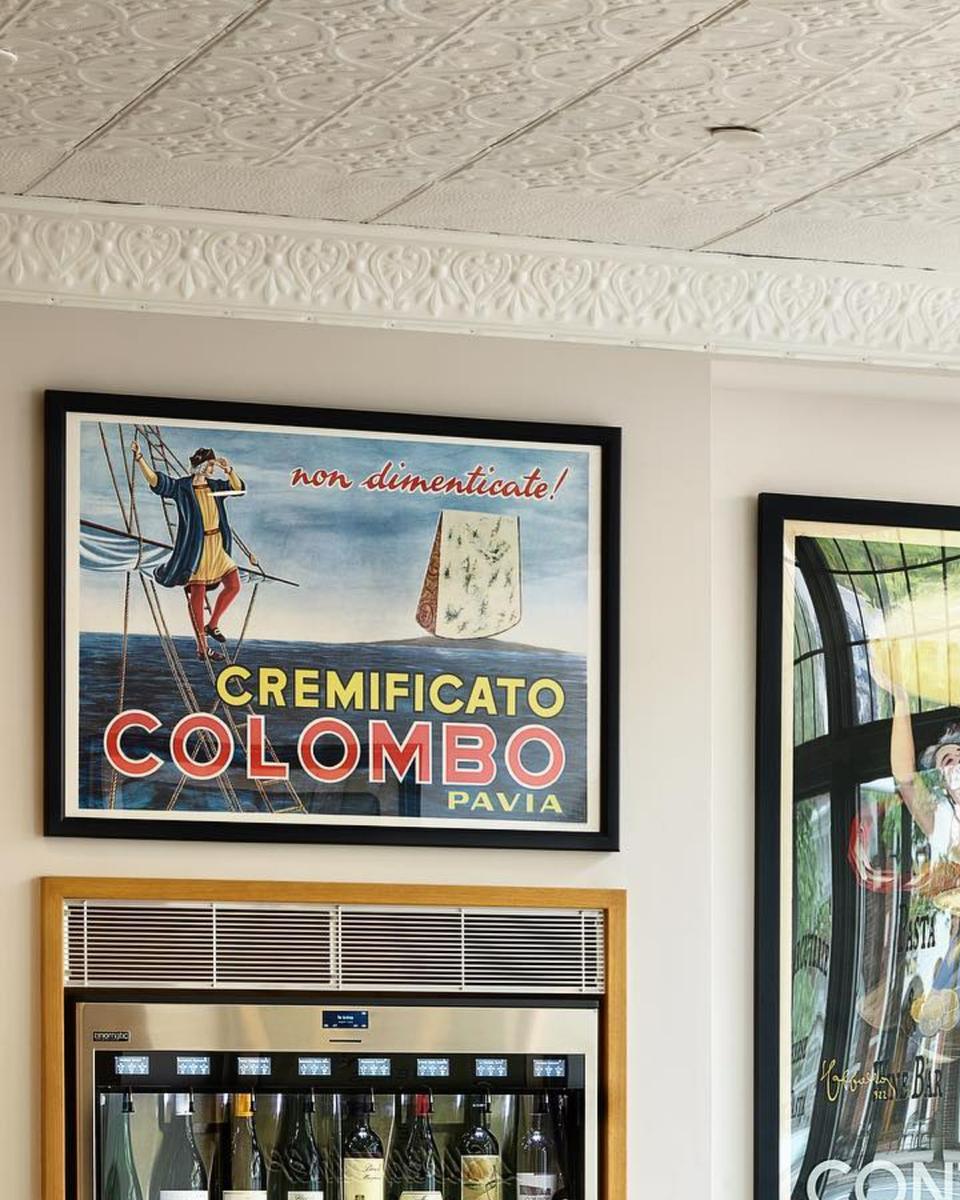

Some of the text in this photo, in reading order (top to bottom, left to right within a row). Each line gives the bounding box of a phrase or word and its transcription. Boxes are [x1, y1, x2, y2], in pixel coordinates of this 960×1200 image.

[291, 461, 569, 500] non dimenticate!
[216, 665, 566, 719] CREMIFICATO
[103, 709, 566, 790] COLOMBO
[447, 790, 563, 814] PAVIA
